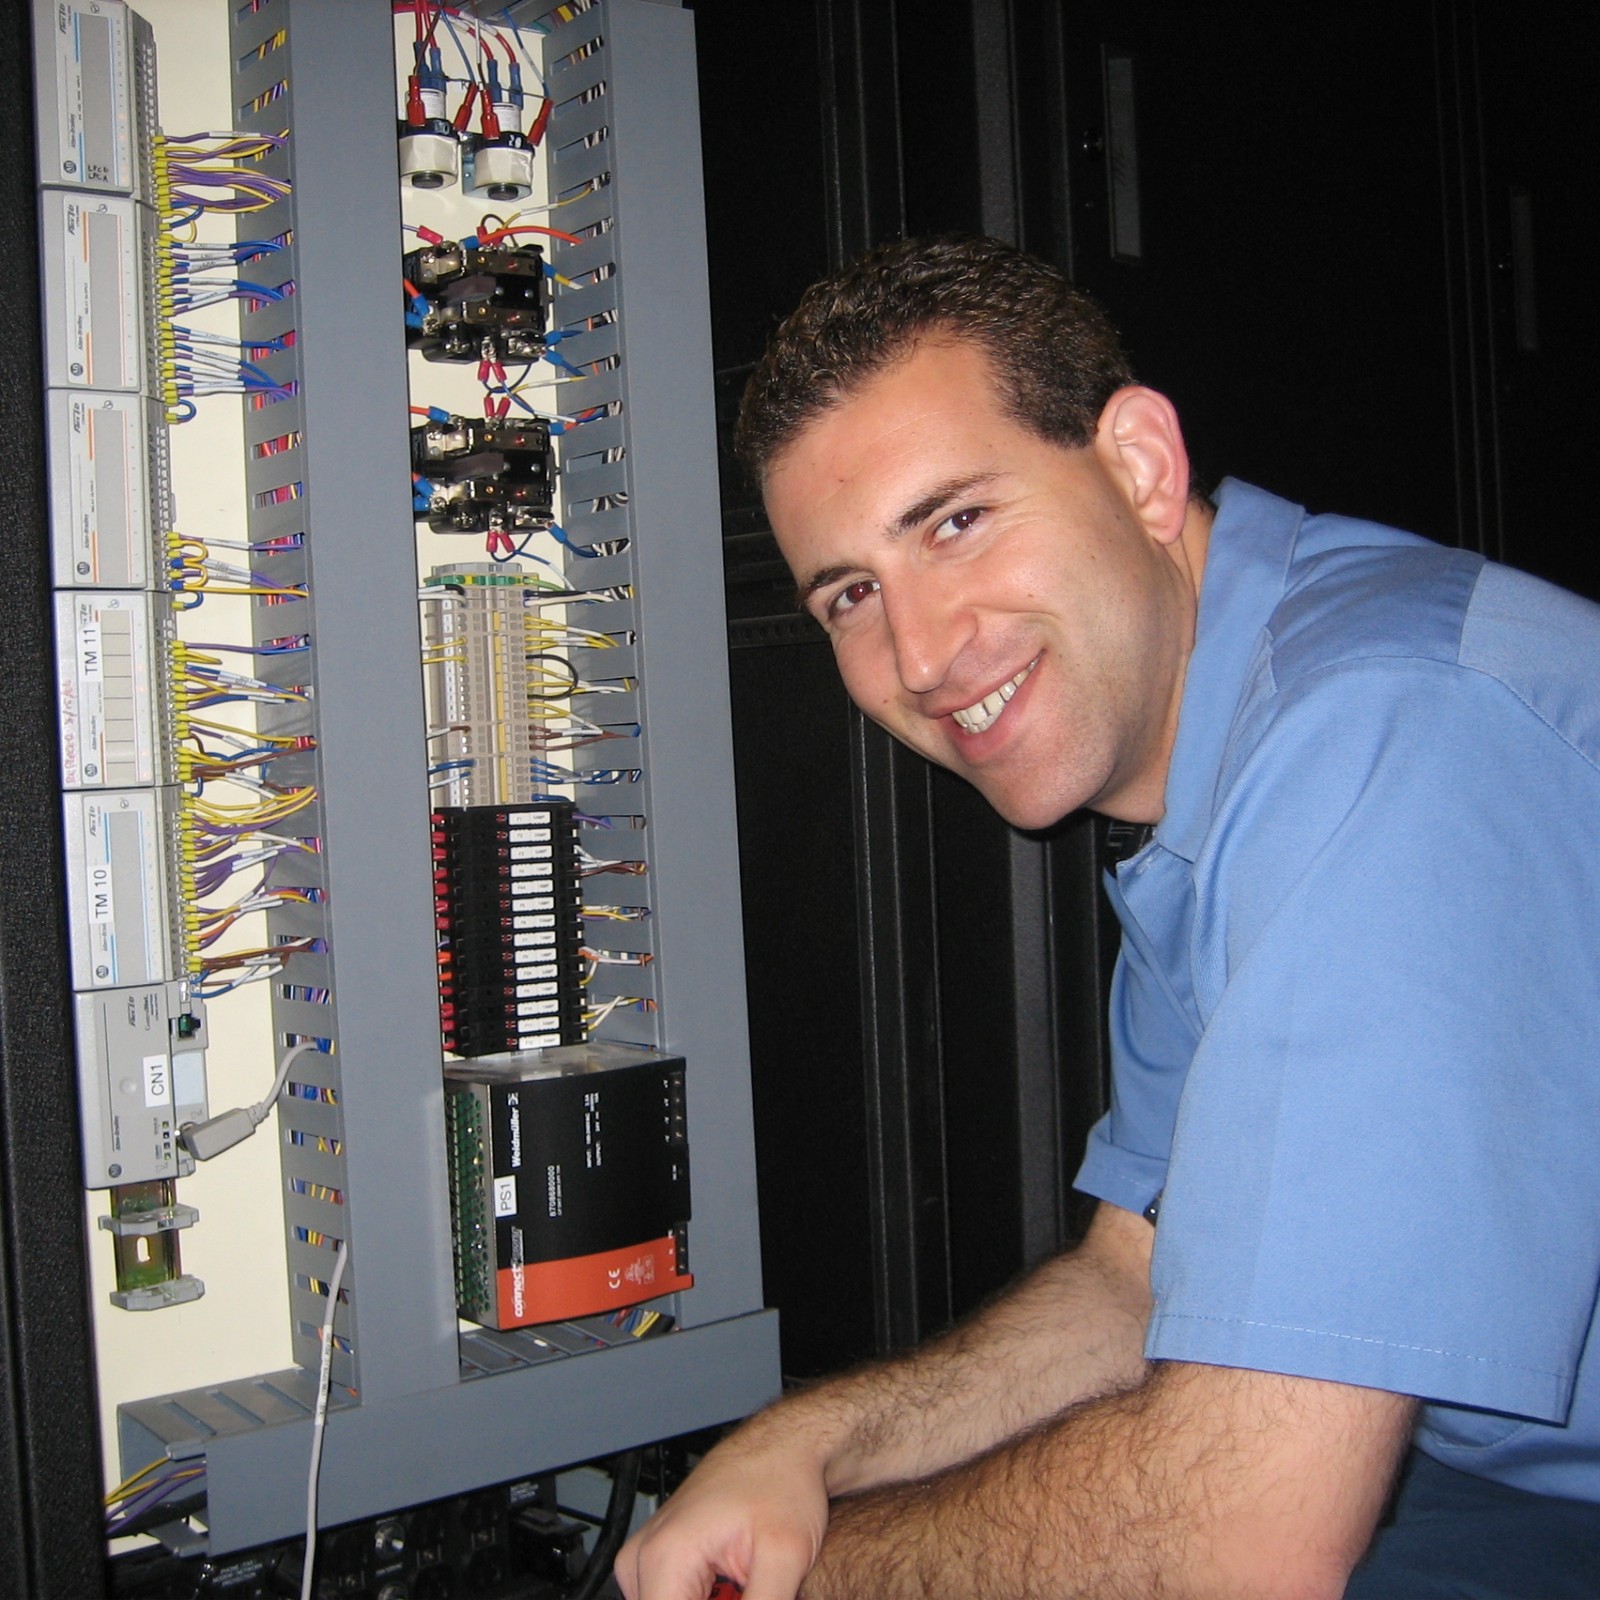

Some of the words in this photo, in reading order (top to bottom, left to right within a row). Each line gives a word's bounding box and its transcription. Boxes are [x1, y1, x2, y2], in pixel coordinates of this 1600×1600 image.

[84, 629, 96, 645] 11
[85, 651, 98, 675] TM
[93, 870, 107, 886] 10
[95, 894, 108, 918] TM
[151, 1063, 164, 1096] CN1
[510, 1108, 521, 1167] Weidmüller
[500, 1183, 512, 1211] PS1
